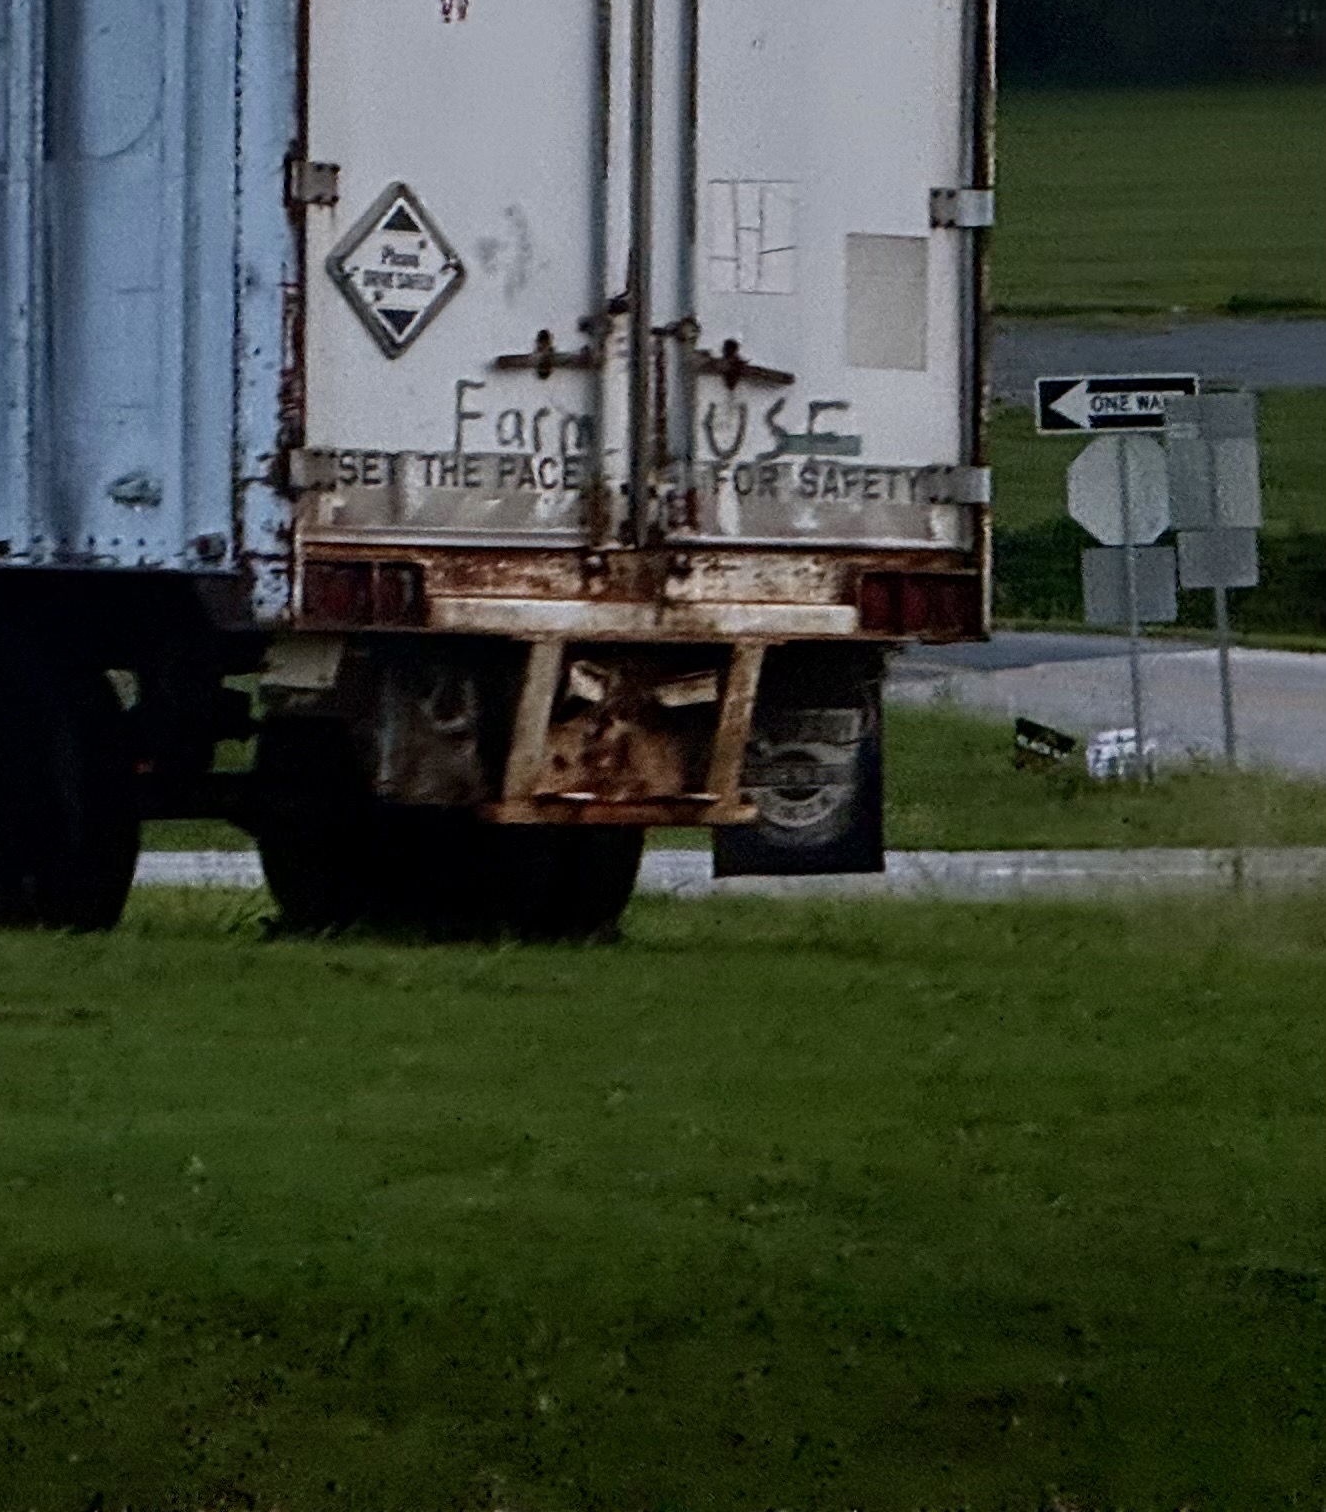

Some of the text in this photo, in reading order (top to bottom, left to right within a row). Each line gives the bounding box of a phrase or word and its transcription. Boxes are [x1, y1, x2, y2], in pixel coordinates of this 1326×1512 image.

[1091, 394, 1168, 413] ONE WA
[498, 455, 583, 490] PACE
